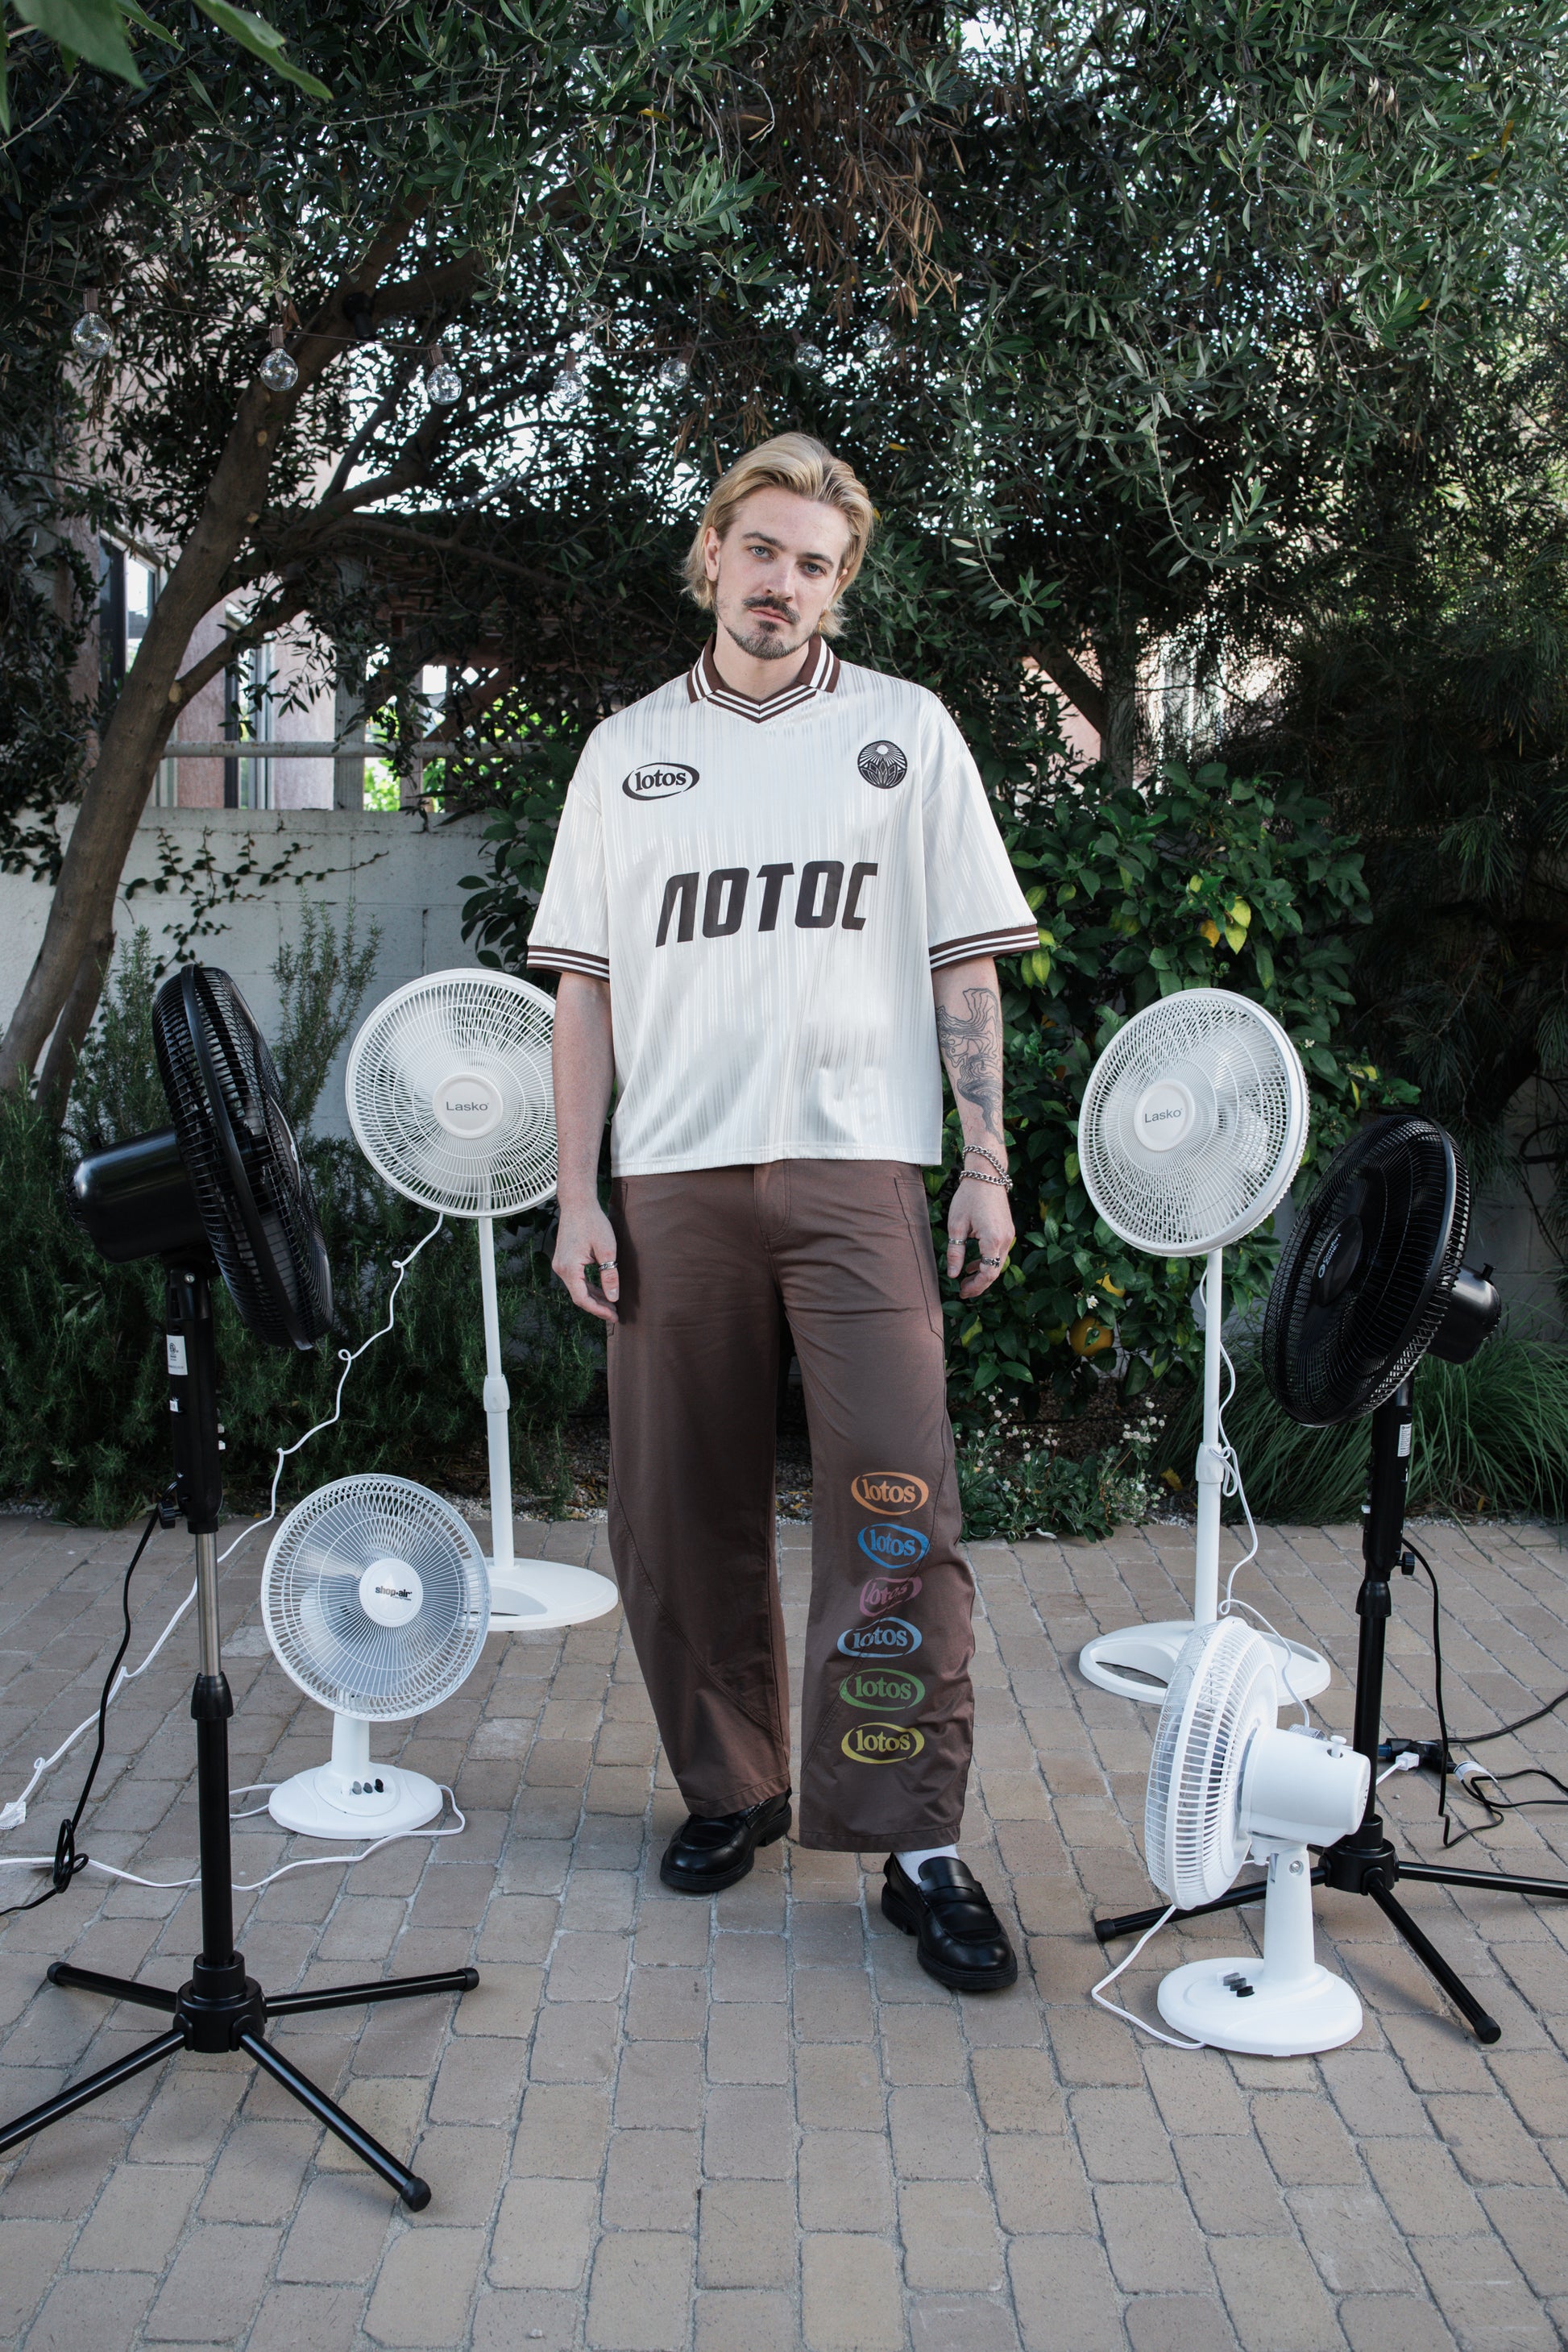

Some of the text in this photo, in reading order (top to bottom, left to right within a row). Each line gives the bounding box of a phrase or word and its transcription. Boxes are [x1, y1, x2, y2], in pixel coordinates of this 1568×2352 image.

[634, 769, 687, 792] lotos
[655, 860, 879, 948] ЛОТОС
[446, 1101, 488, 1111] Lasko
[1144, 1109, 1182, 1123] Lasko
[861, 1478, 916, 1504] lotos
[869, 1529, 916, 1557] lotos
[852, 1626, 908, 1649] lotos
[854, 1675, 912, 1700] lotos
[856, 1729, 911, 1753] lotos
